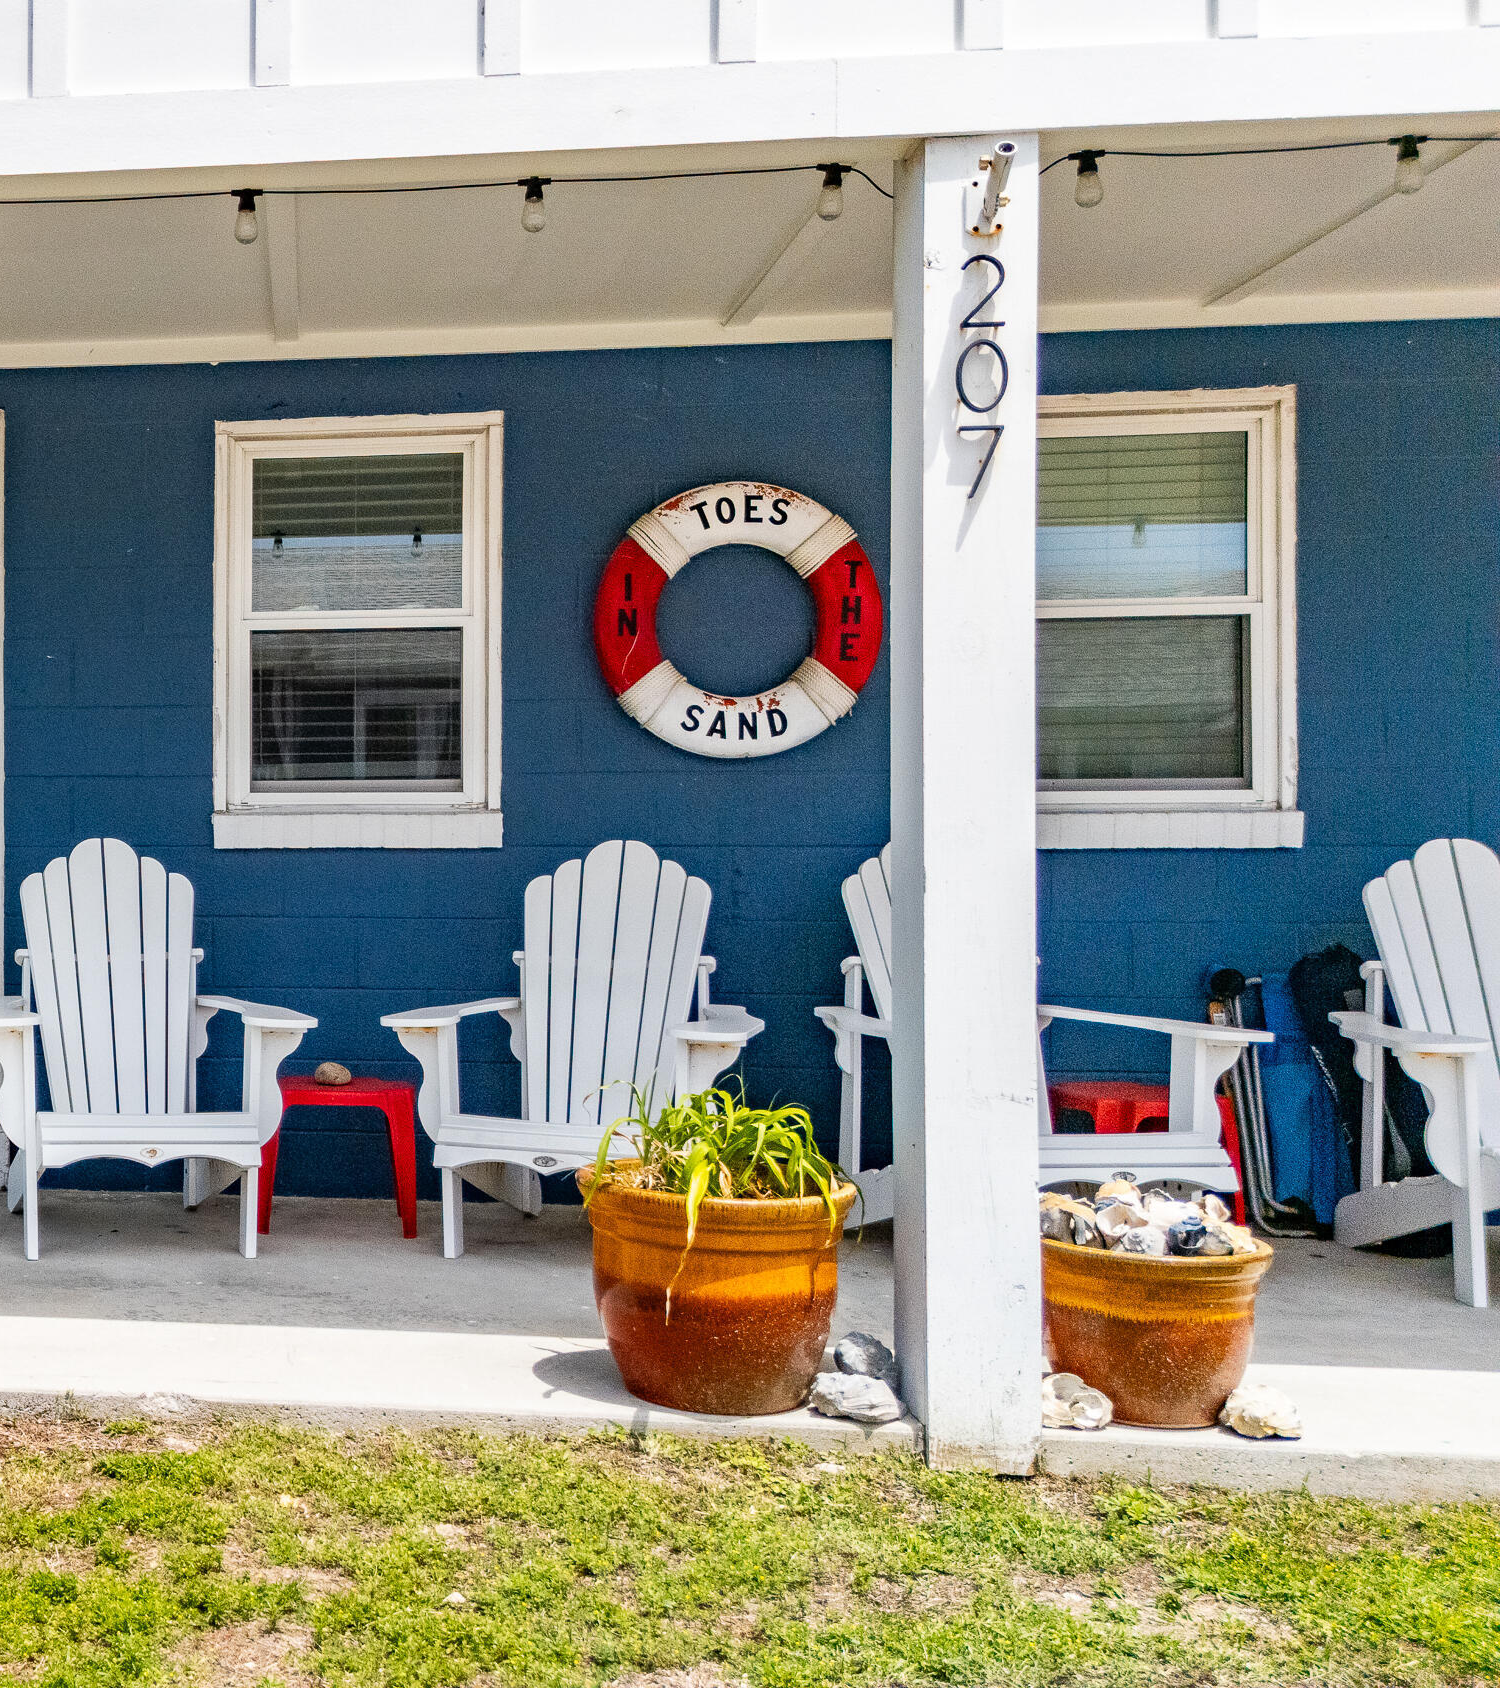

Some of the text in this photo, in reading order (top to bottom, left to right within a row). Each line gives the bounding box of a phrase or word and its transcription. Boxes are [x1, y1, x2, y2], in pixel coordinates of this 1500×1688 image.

[956, 254, 1008, 499] 207
[690, 495, 791, 530] TOES
[617, 573, 638, 636] IN
[839, 560, 863, 661] THE
[680, 705, 788, 741] SAND
